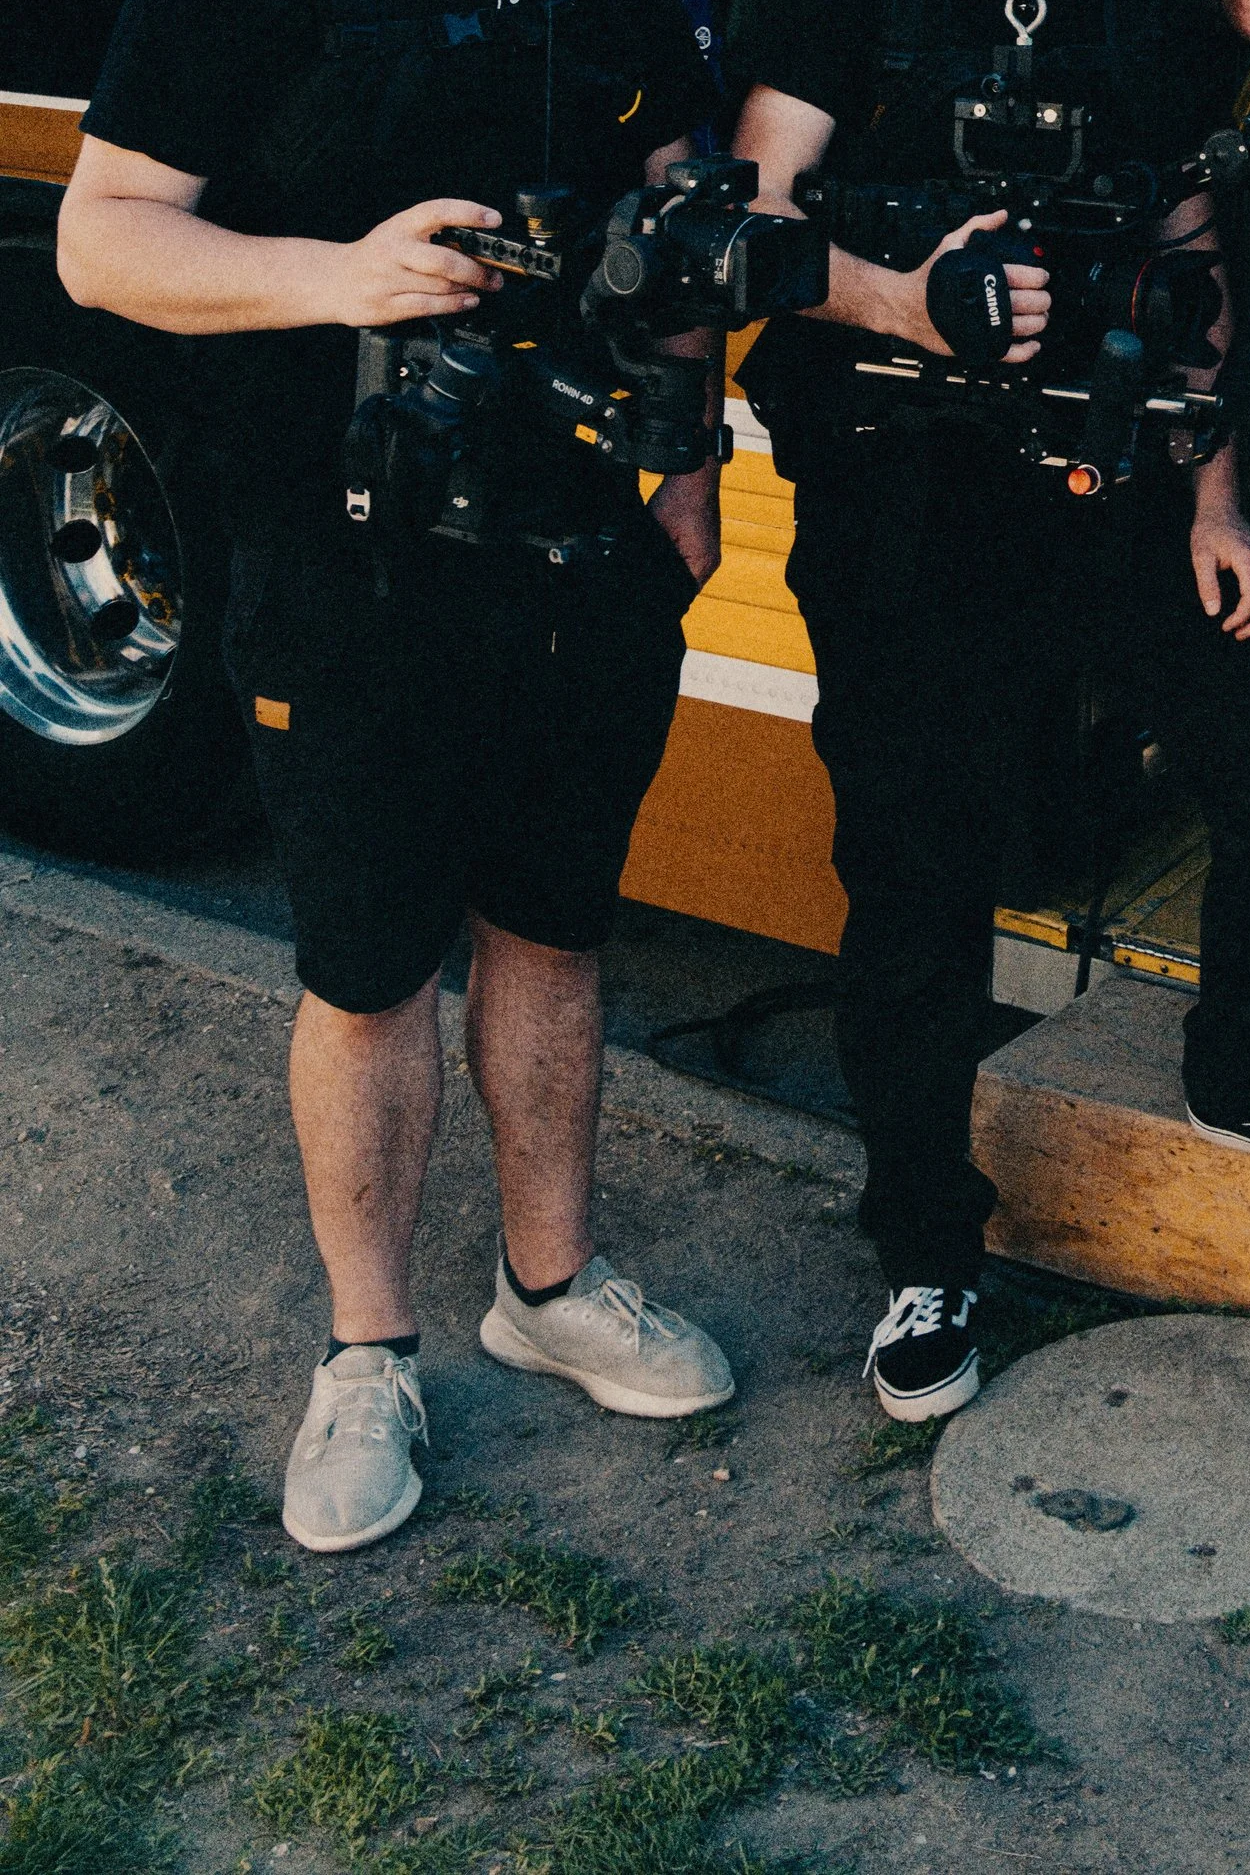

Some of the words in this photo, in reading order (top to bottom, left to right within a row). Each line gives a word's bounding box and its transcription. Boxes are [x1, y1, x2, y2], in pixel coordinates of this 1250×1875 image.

[984, 274, 1001, 326] Canon
[552, 379, 581, 400] RONIN
[579, 394, 594, 405] 4D
